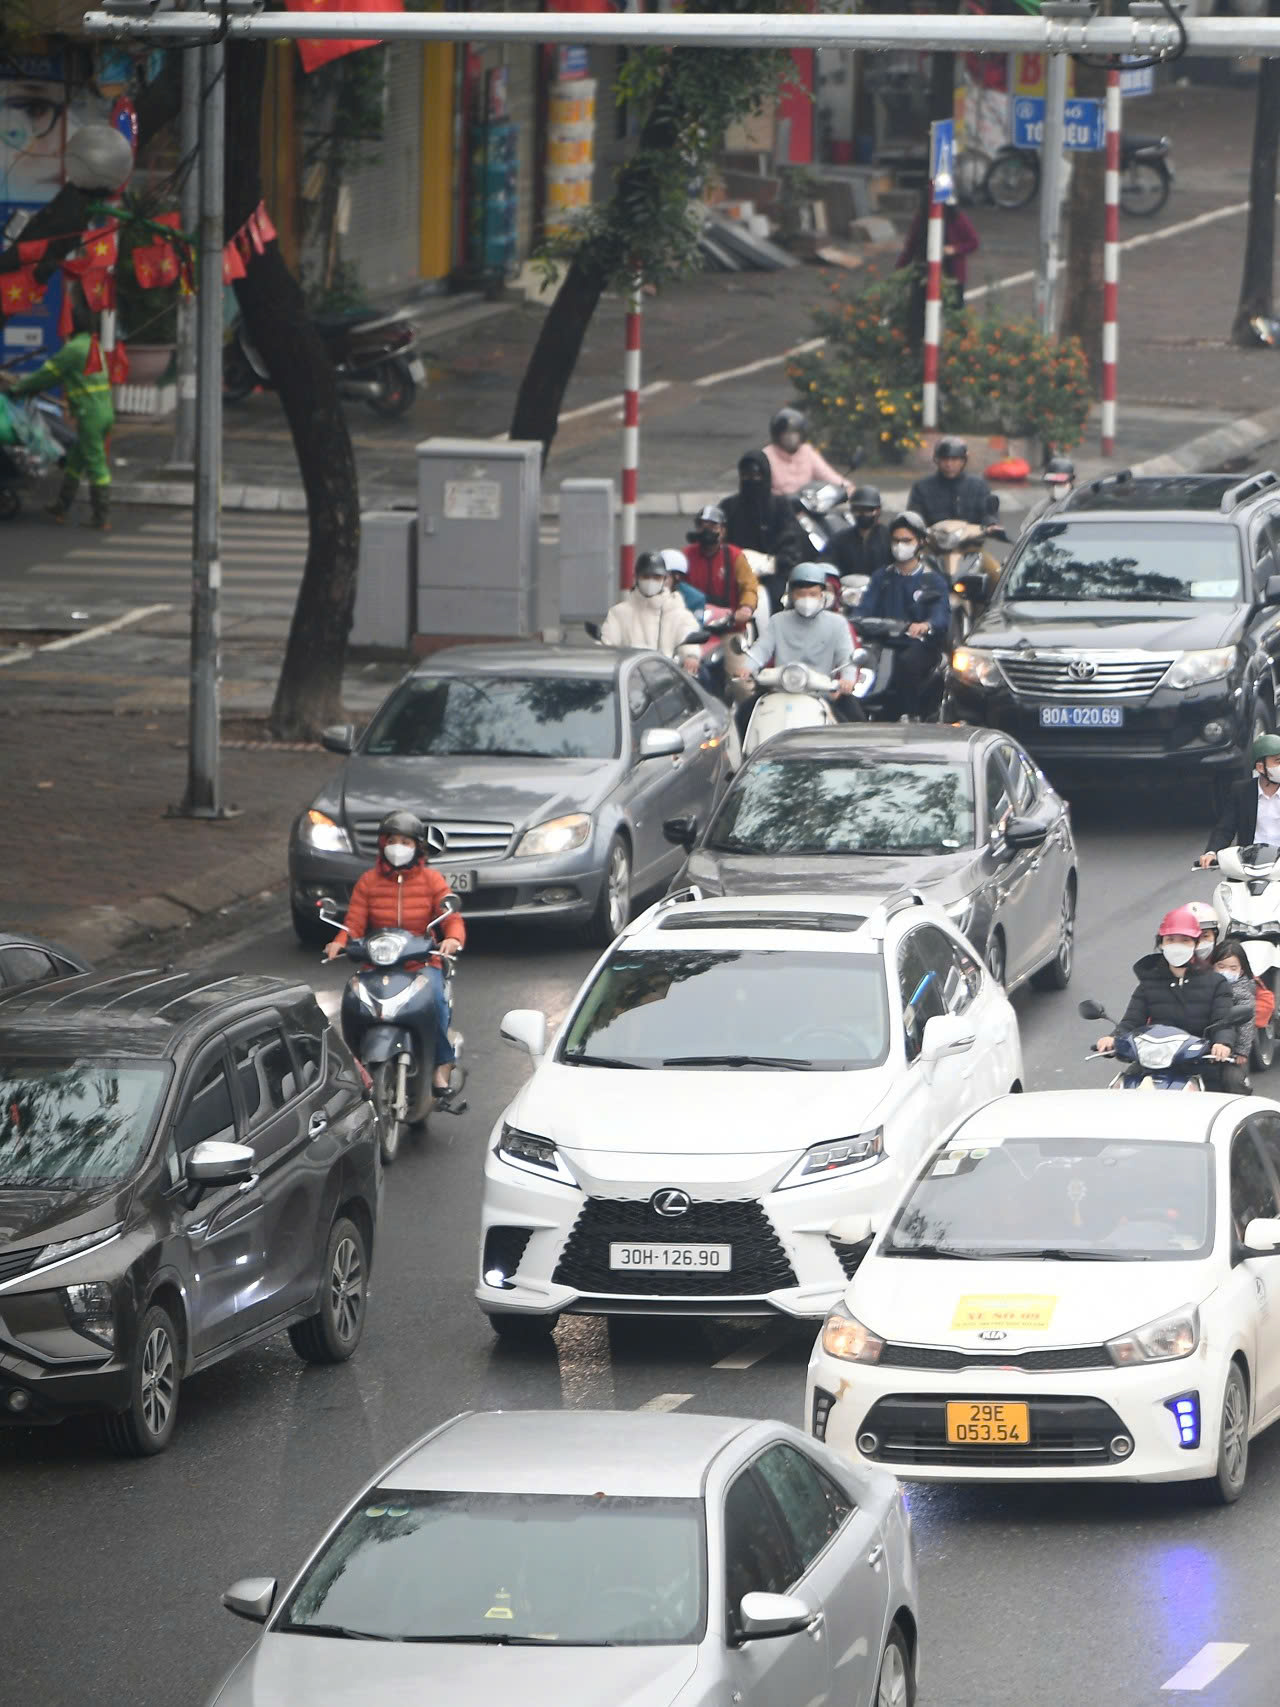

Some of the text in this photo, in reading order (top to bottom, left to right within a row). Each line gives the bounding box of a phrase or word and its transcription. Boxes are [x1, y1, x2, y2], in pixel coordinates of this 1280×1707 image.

[1042, 708, 1120, 725] 80A-020.69
[620, 1248, 720, 1266] 30H-126.90
[981, 1330, 1005, 1339] KIA
[970, 1405, 1005, 1422] 29E
[956, 1424, 1020, 1441] 053.54
